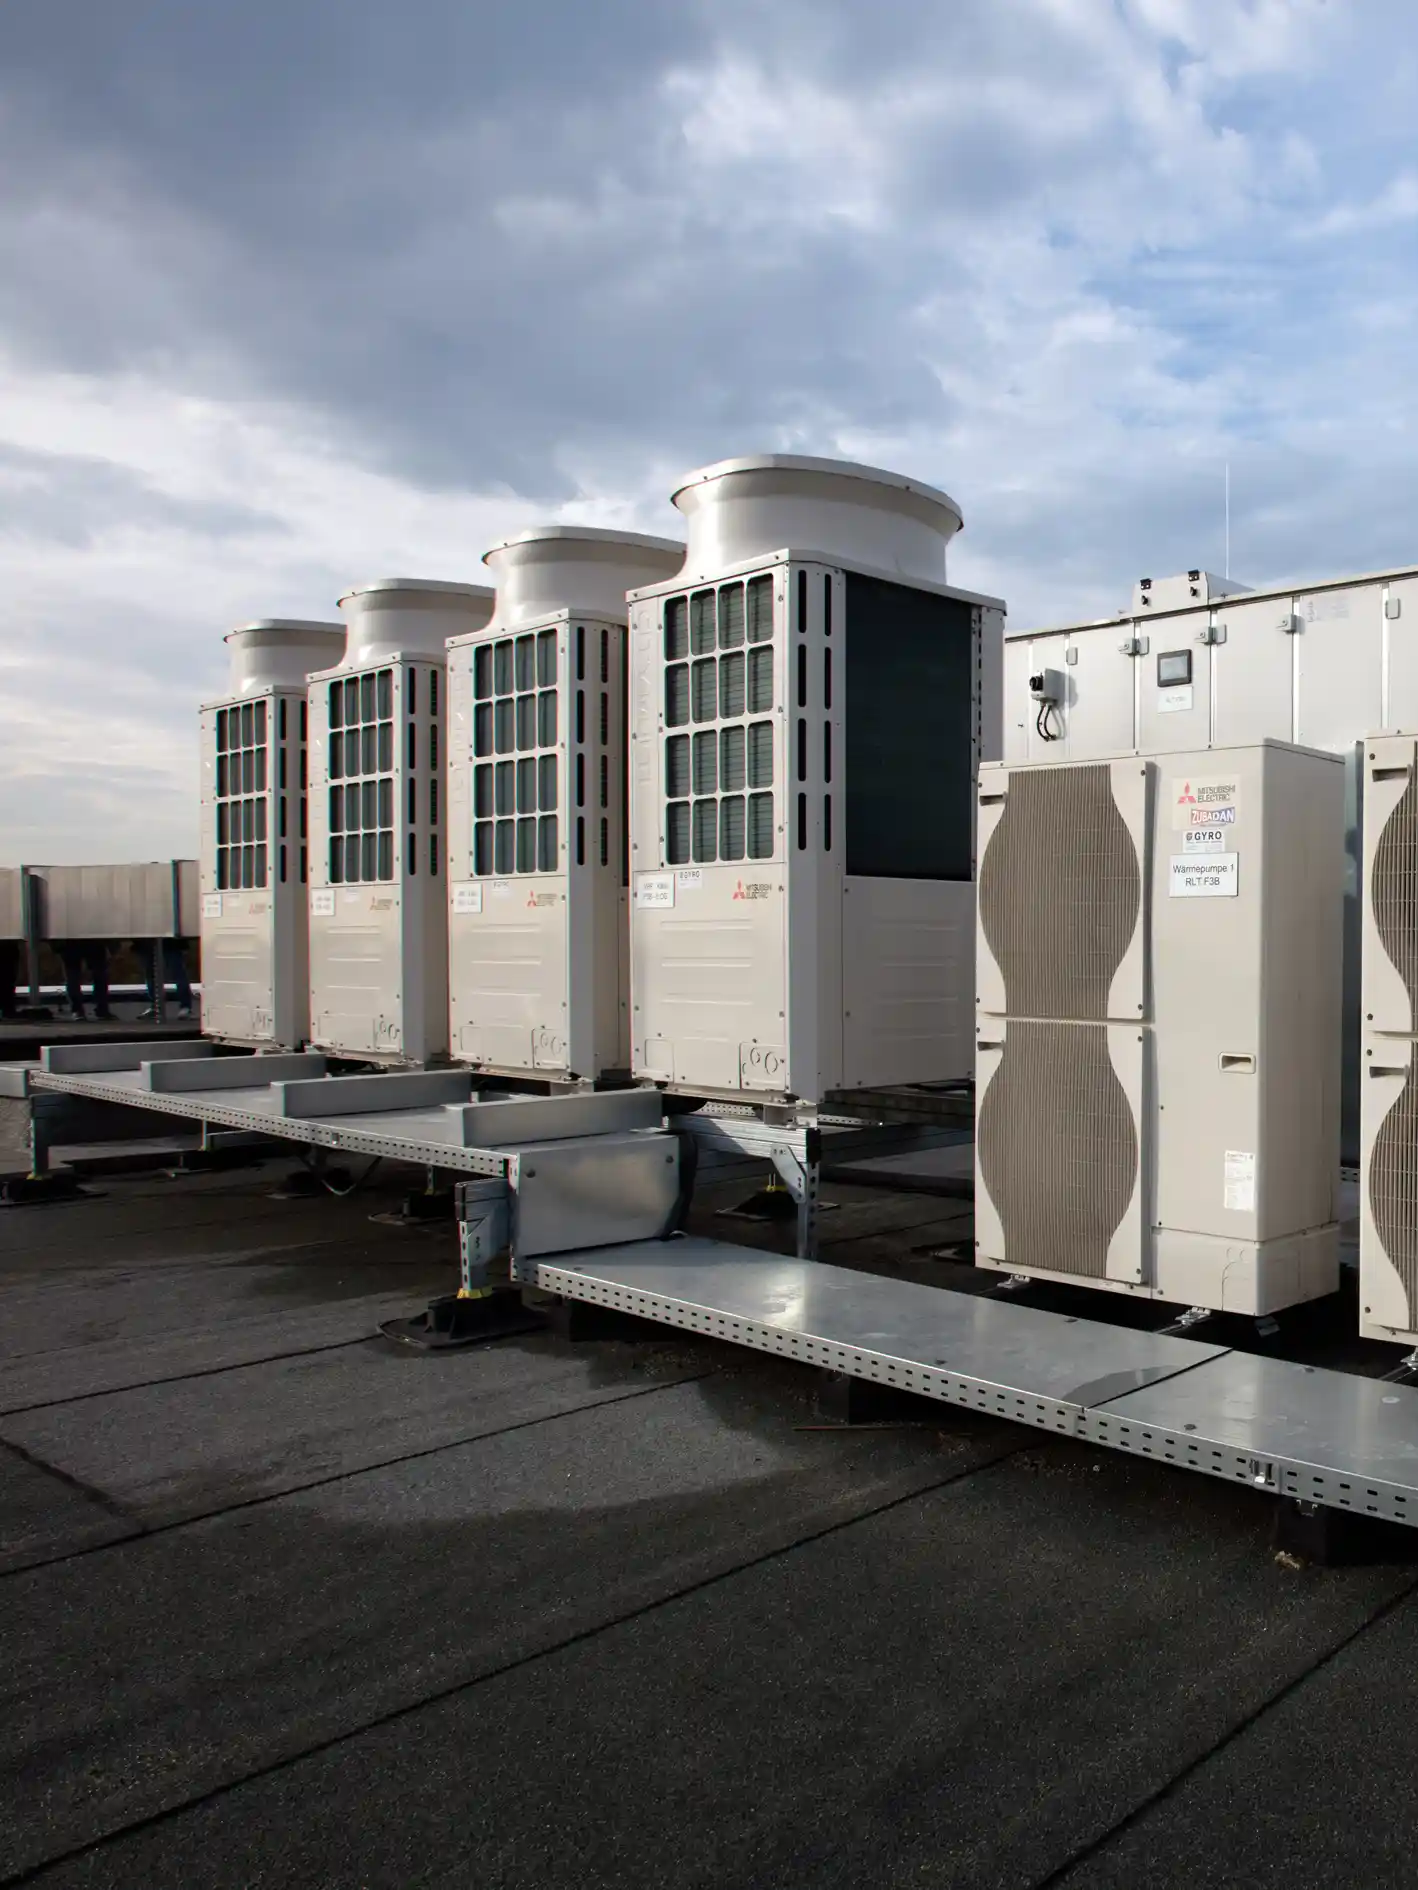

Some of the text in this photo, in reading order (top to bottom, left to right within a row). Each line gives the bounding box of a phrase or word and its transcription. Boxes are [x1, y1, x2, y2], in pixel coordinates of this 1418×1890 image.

[1197, 785, 1236, 795] MITSUBISHI
[1192, 808, 1234, 823] ZUBADAN
[1194, 831, 1222, 840] GYRO
[1173, 863, 1235, 874] Wärmepumpe 1
[1185, 876, 1220, 886] RLT F3B
